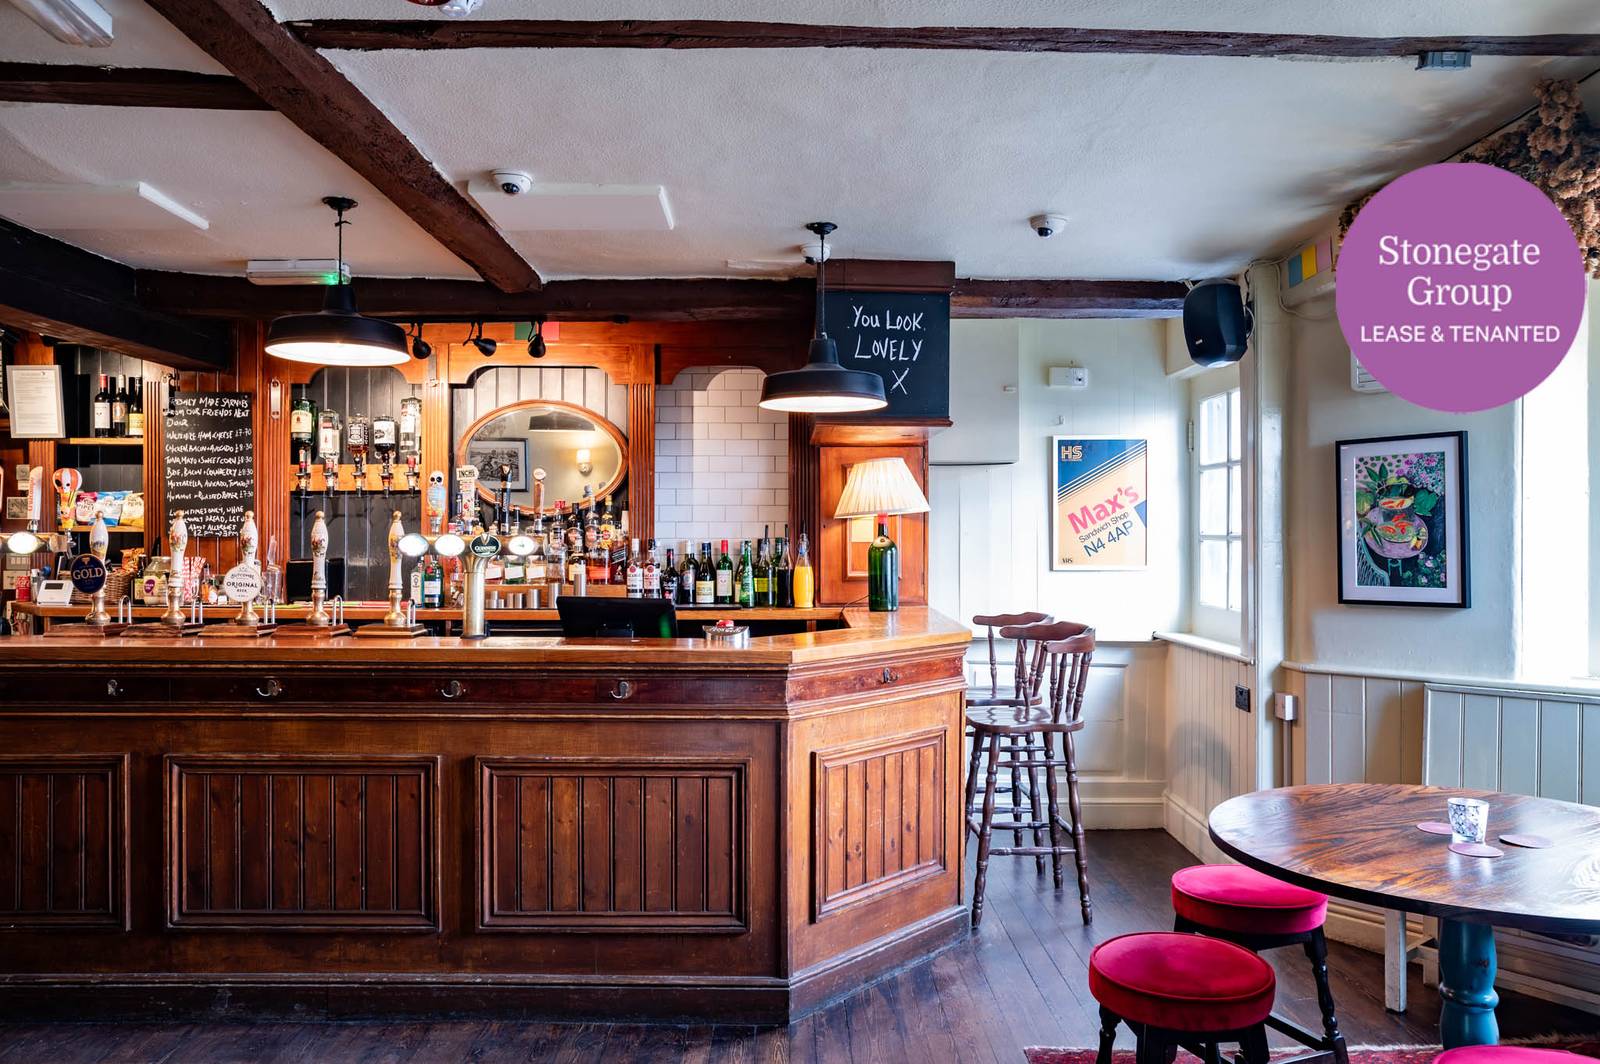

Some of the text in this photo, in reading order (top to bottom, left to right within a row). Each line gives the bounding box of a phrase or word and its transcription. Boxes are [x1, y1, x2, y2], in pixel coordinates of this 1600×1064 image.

[886, 309, 924, 331] LOOK
[854, 333, 924, 362] LOVELY
[202, 408, 232, 418] FRIENDS
[1061, 445, 1083, 461] HS
[1067, 486, 1140, 535] Max's
[1078, 510, 1130, 543] Sandwich Shop
[1083, 520, 1134, 557] N4 4AP
[72, 567, 103, 580] GOLD
[226, 581, 258, 589] ORIGINAL
